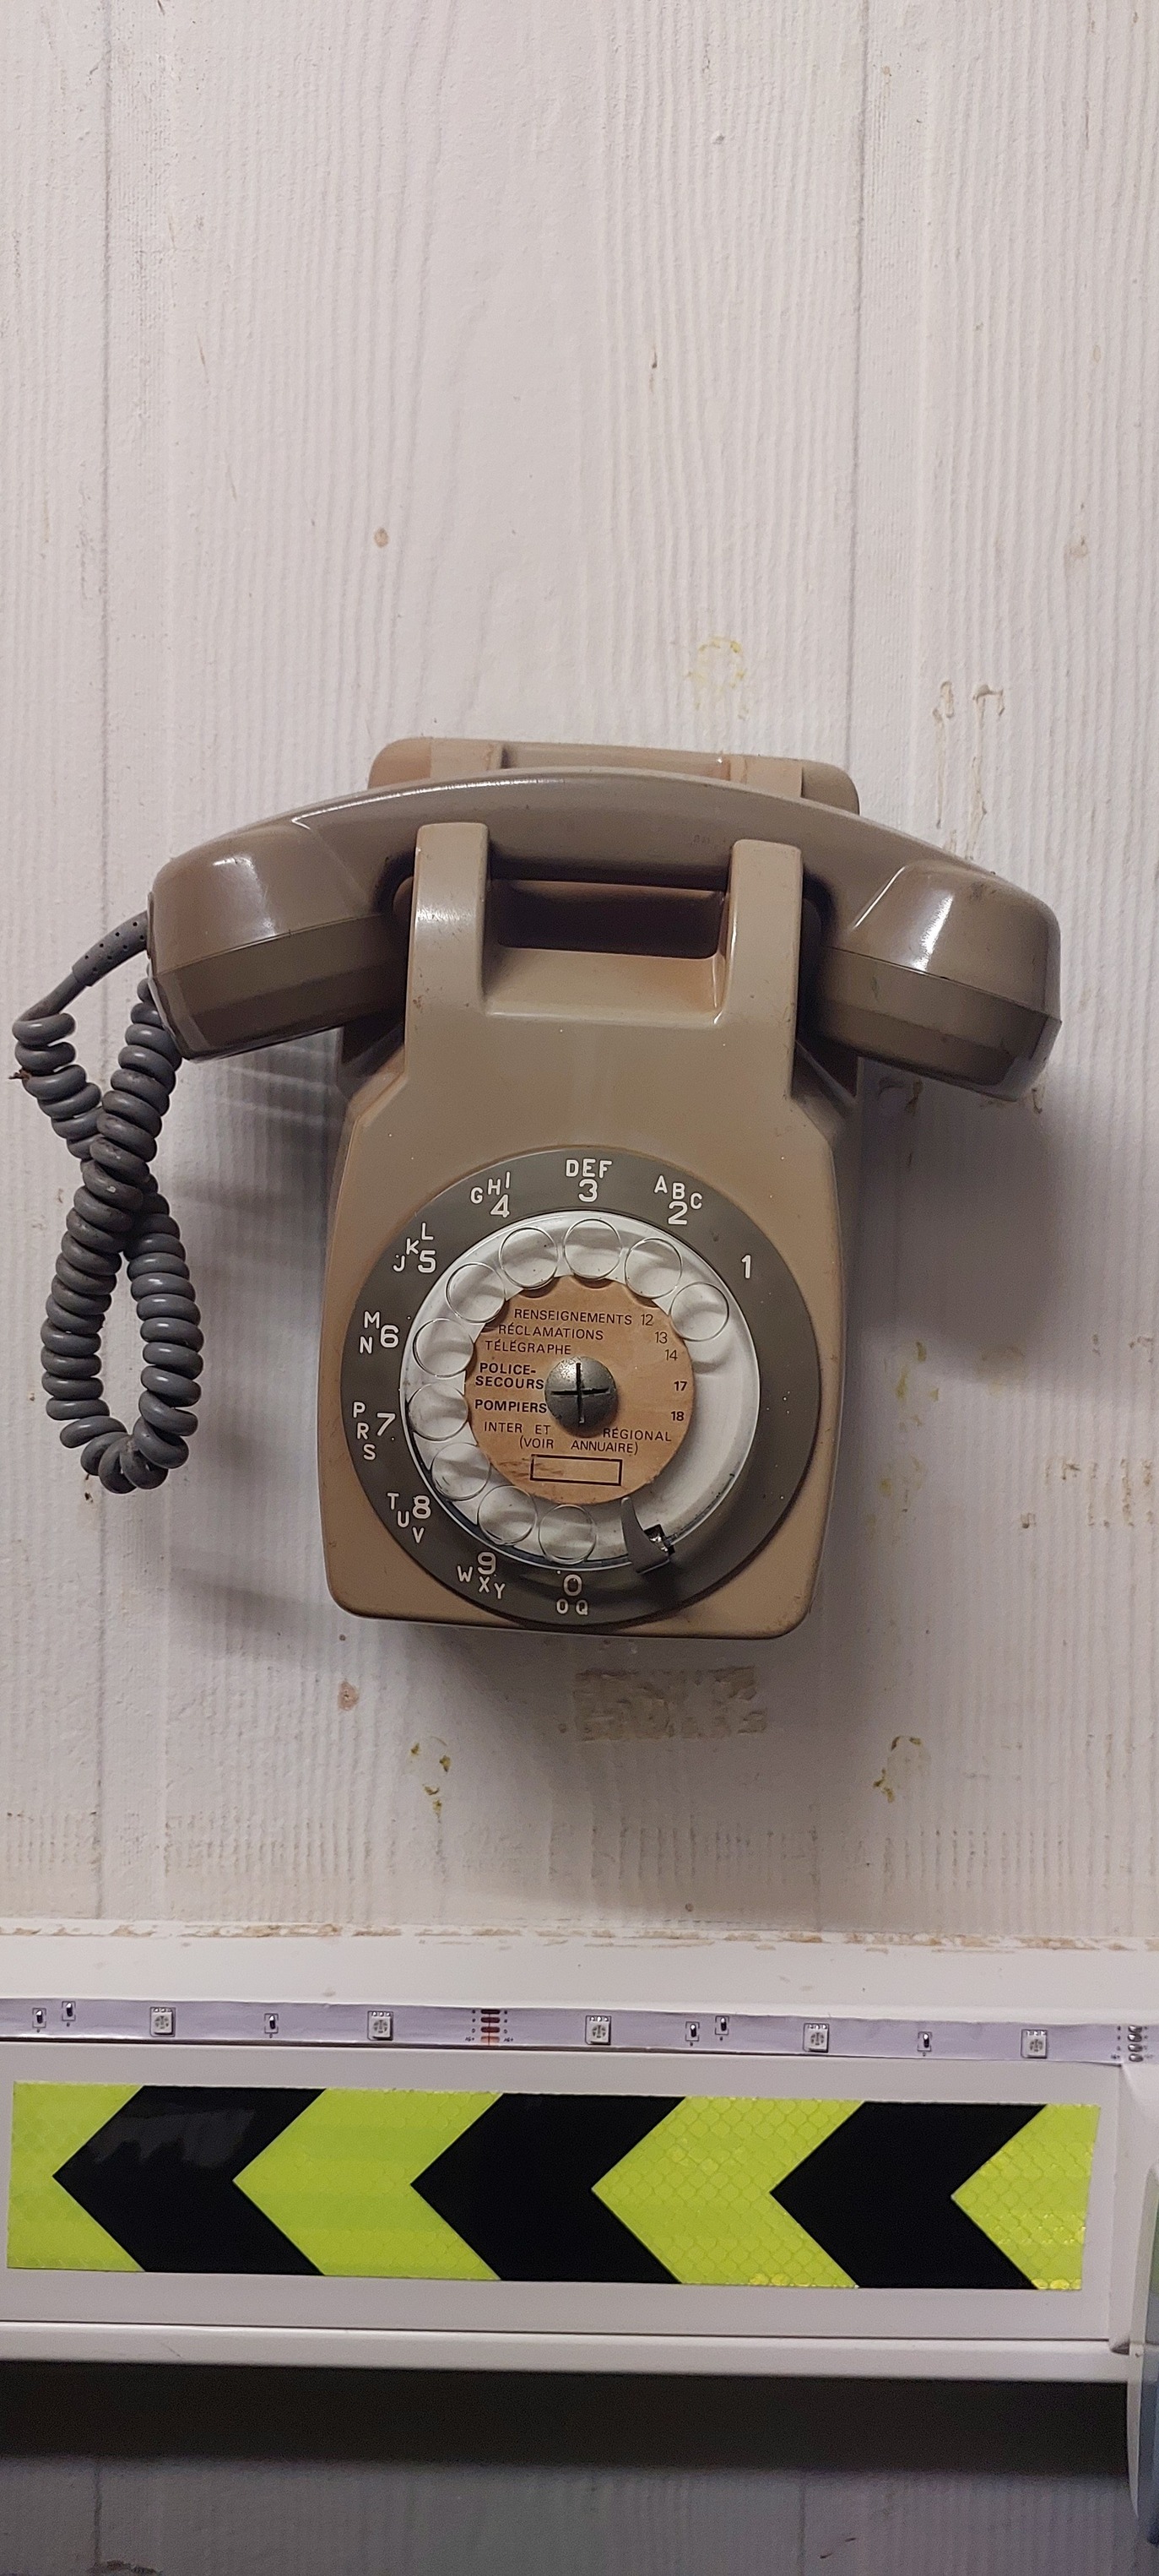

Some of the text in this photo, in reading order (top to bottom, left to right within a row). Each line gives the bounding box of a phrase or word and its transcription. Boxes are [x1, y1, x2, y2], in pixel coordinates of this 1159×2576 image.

[565, 1158, 613, 1179] DEF
[578, 1179, 598, 1202] 3
[490, 1194, 510, 1218] 4
[668, 1201, 688, 1225] 2
[417, 1250, 436, 1273] 5
[741, 1254, 752, 1279] 1
[514, 1308, 654, 1326] RENSEIGNEMENTS 12
[380, 1325, 399, 1348] 6
[498, 1322, 669, 1344] RÉCLAMATIONS 13
[485, 1339, 679, 1362] TÉLÉGRAPHE 14
[479, 1362, 537, 1375] POLICE-
[474, 1375, 688, 1392] SECOURS 17
[474, 1399, 685, 1422] POMPIERS 18
[376, 1413, 396, 1436] 7
[484, 1421, 673, 1442] INTER ET RÉGIONAL
[519, 1435, 639, 1456] (VOIR ANNUAIRE)
[412, 1495, 431, 1519] 8
[477, 1552, 496, 1575] 9
